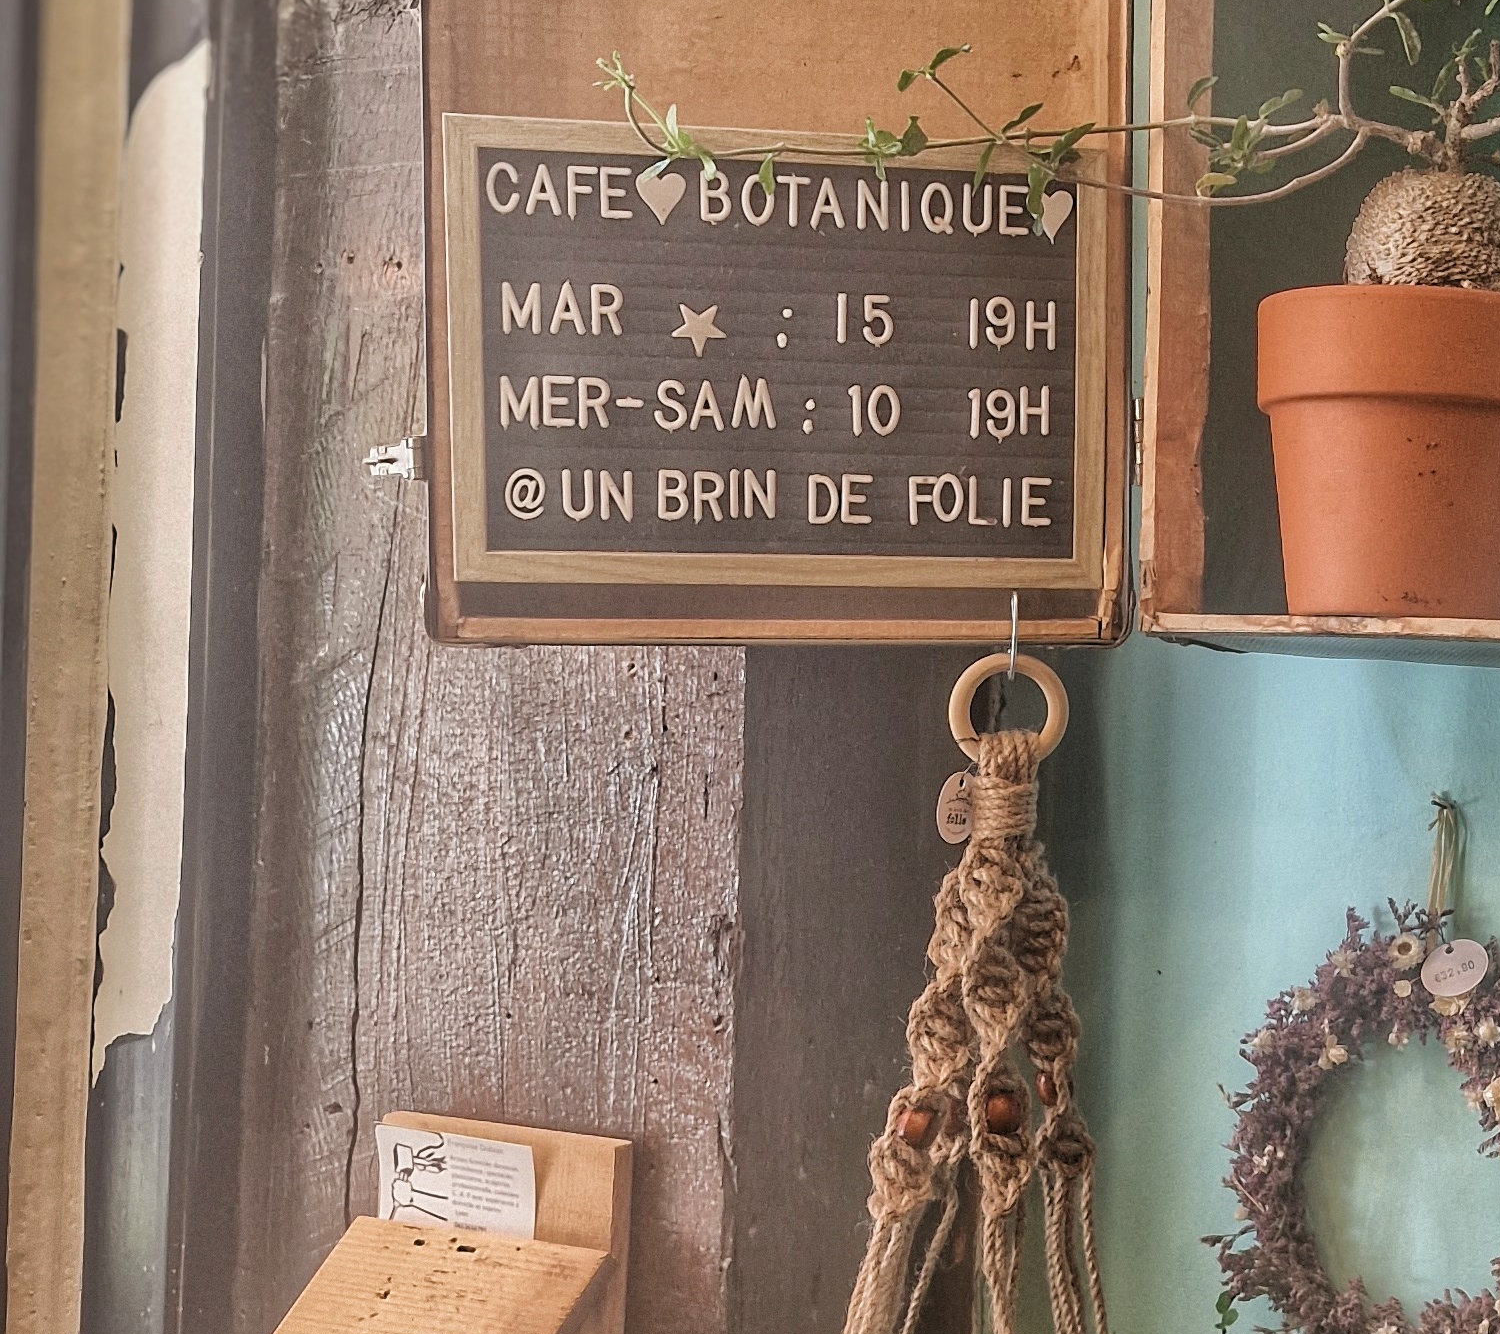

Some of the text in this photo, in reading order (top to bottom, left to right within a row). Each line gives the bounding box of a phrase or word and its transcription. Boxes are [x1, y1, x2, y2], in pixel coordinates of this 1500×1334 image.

[485, 161, 1030, 237] CAFE BOTANIQUE
[500, 279, 625, 336] MAR
[835, 292, 894, 348] 15
[968, 296, 1057, 351] 19H
[499, 373, 778, 432] MER-SAM
[848, 383, 901, 437] 10
[967, 385, 1051, 443] 19H
[657, 468, 777, 523] BRIN
[807, 473, 874, 525] DE
[908, 473, 1053, 528] FOLIE
